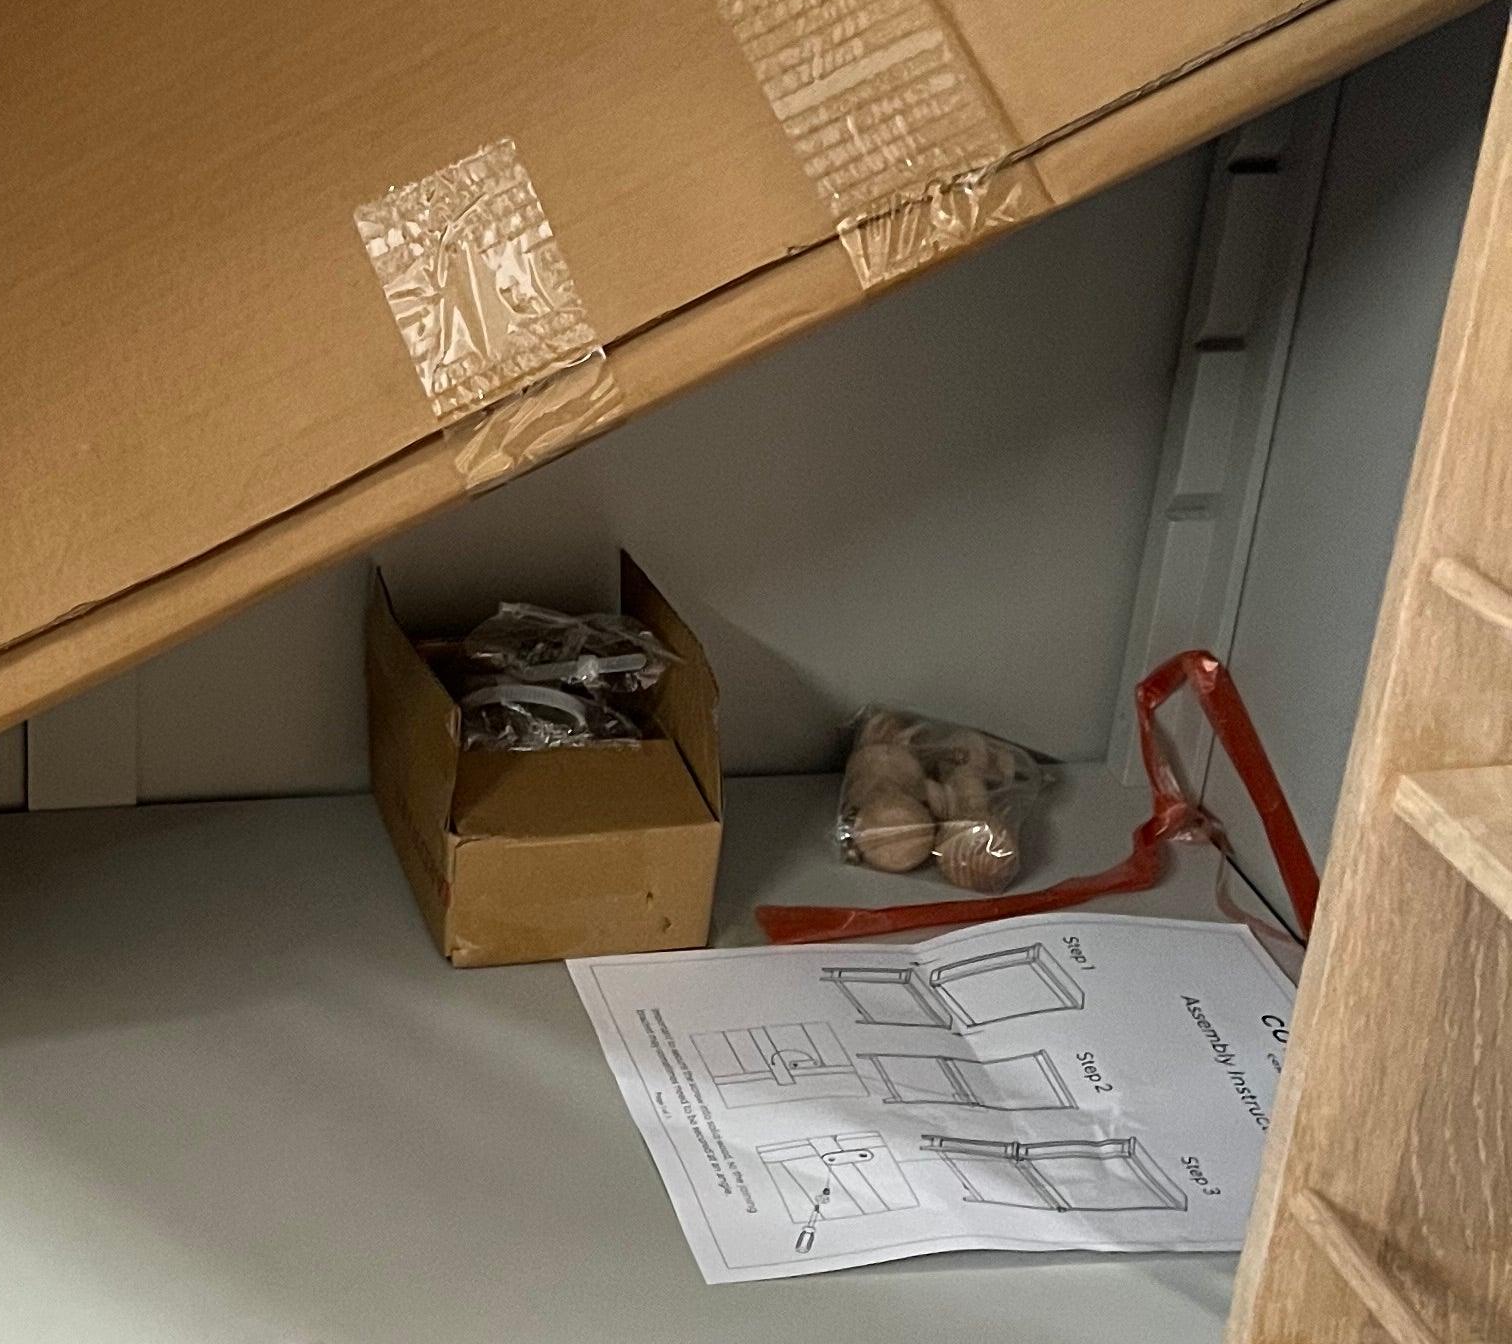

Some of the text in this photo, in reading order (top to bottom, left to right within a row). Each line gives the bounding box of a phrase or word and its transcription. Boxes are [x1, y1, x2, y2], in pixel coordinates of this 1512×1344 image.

[1062, 936, 1087, 964] Step
[1076, 1051, 1113, 1094] Step 2
[1180, 994, 1271, 1131] Assembly Instruc
[1180, 1156, 1221, 1196] Step 3
